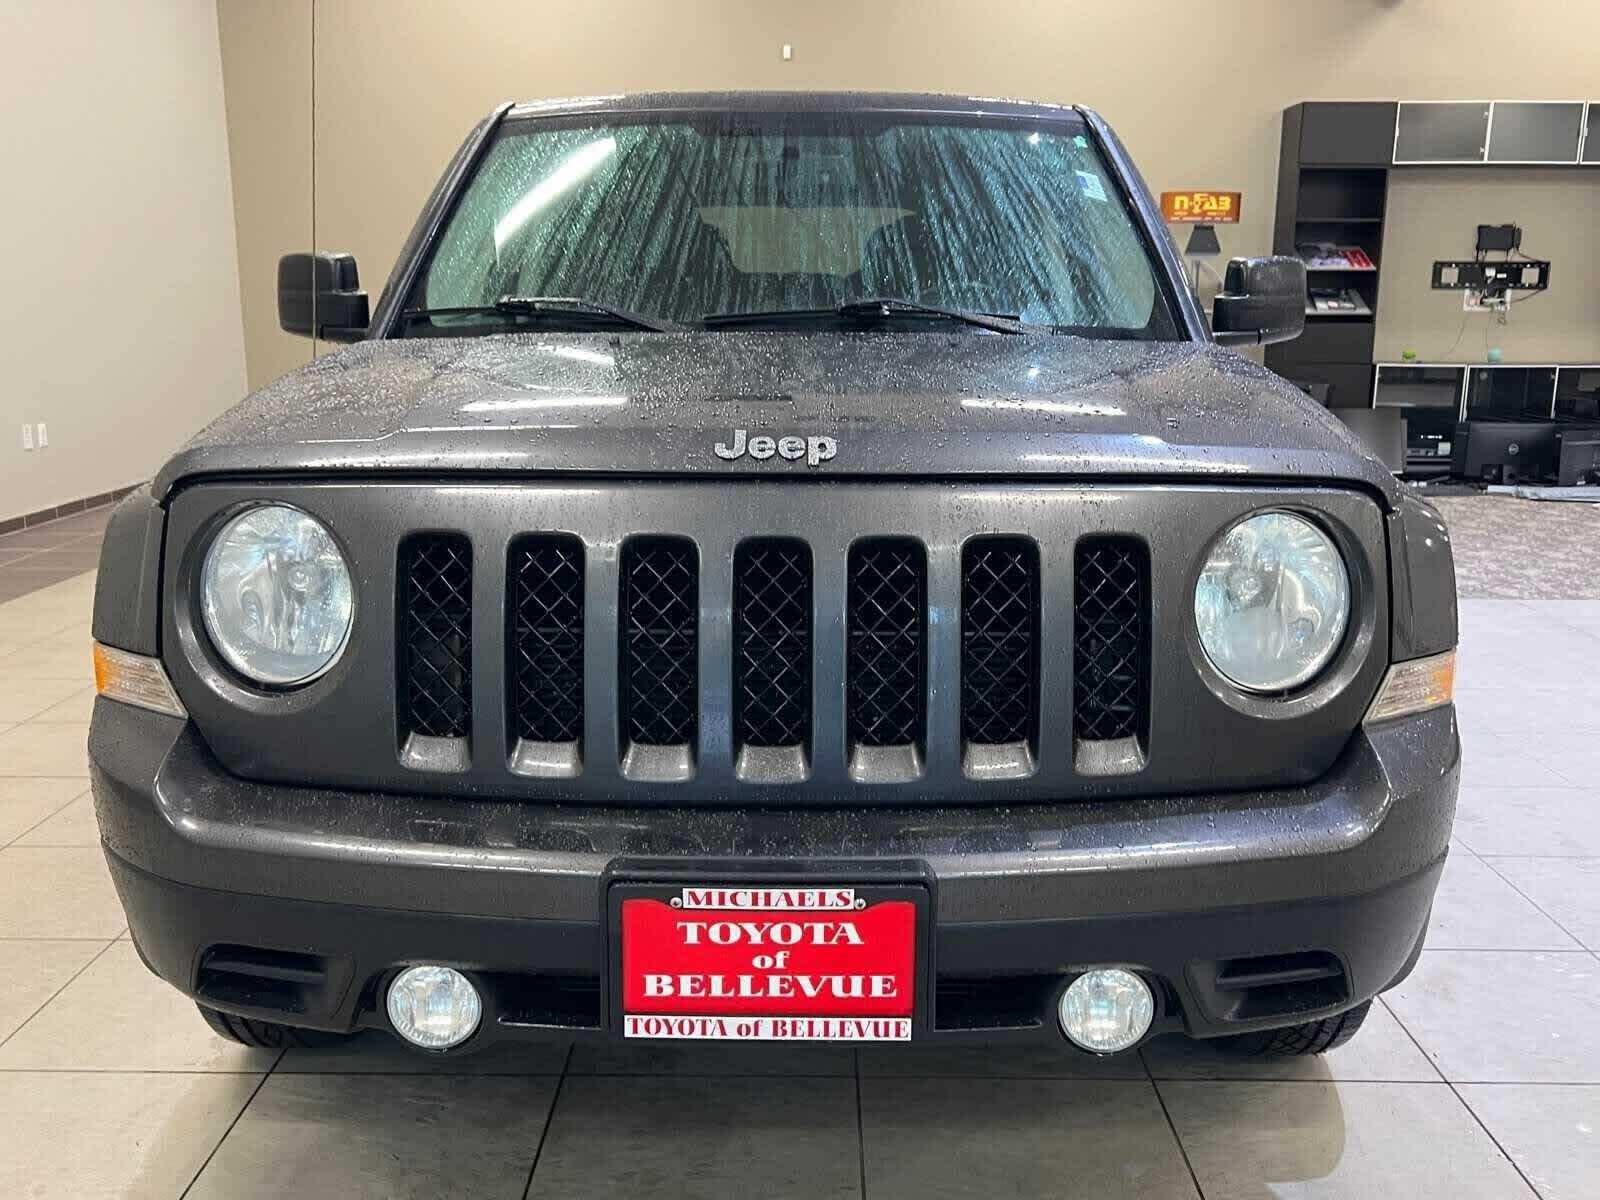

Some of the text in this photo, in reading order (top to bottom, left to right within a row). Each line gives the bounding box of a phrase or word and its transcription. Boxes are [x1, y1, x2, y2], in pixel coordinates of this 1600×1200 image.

[714, 429, 837, 465] Jeep
[686, 890, 852, 907] MICHAELS
[676, 921, 865, 945] TOYOTA
[752, 951, 790, 970] of
[643, 974, 897, 998] BELLEVUE
[627, 1016, 910, 1039] TOYOTA of BELLEVUE
